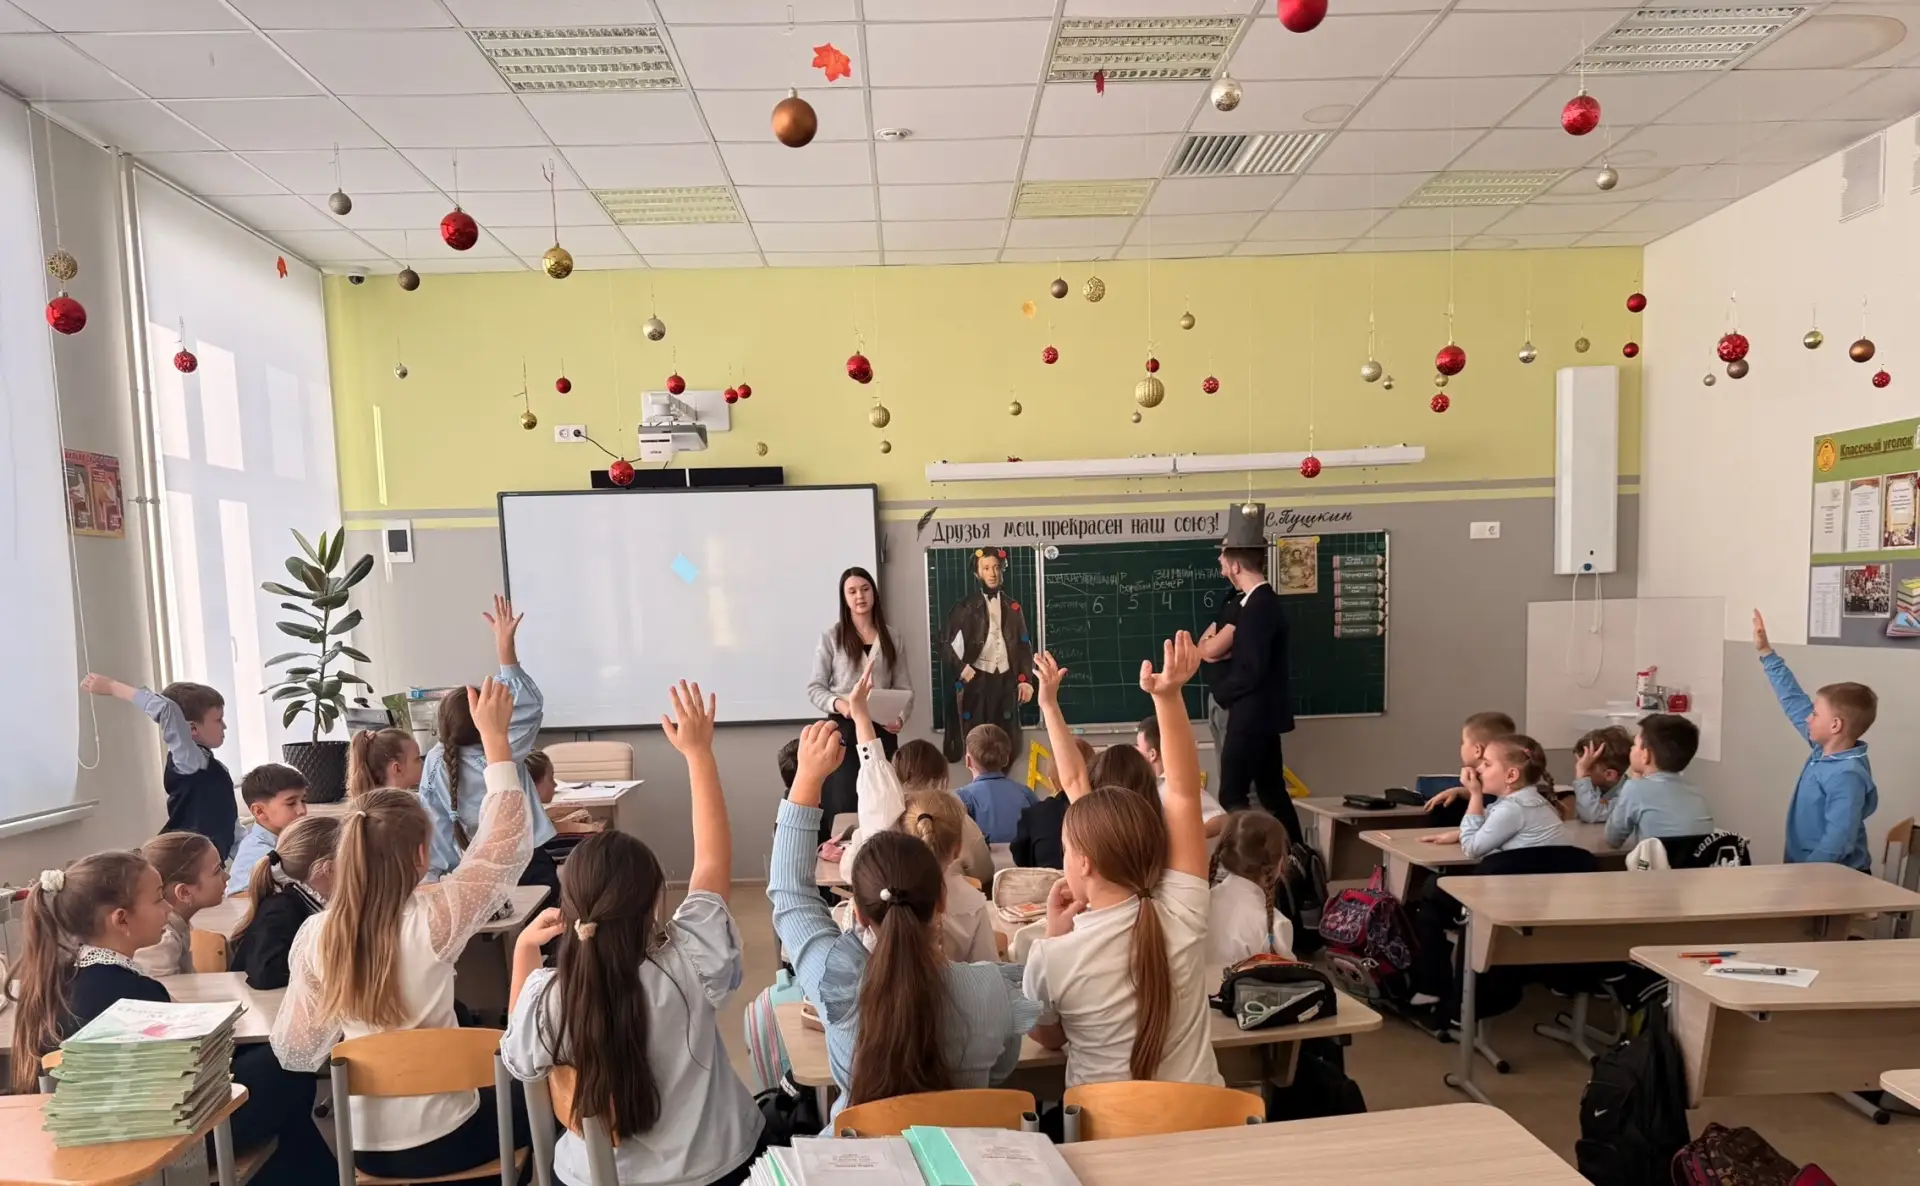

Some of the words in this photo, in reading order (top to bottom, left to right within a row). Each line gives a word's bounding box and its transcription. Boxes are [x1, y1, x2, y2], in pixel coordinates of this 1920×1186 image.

[1840, 439, 1881, 457] Классный
[1883, 436, 1914, 452] уголок
[932, 521, 990, 544] Друзья
[1003, 520, 1040, 538] мои,
[1042, 517, 1123, 540] прекрасен
[1131, 516, 1165, 534] наш
[1174, 512, 1219, 534] союз!
[1092, 596, 1105, 614] 6
[1127, 593, 1139, 610] 5
[1161, 592, 1173, 611] 4
[1203, 590, 1216, 608] 6
